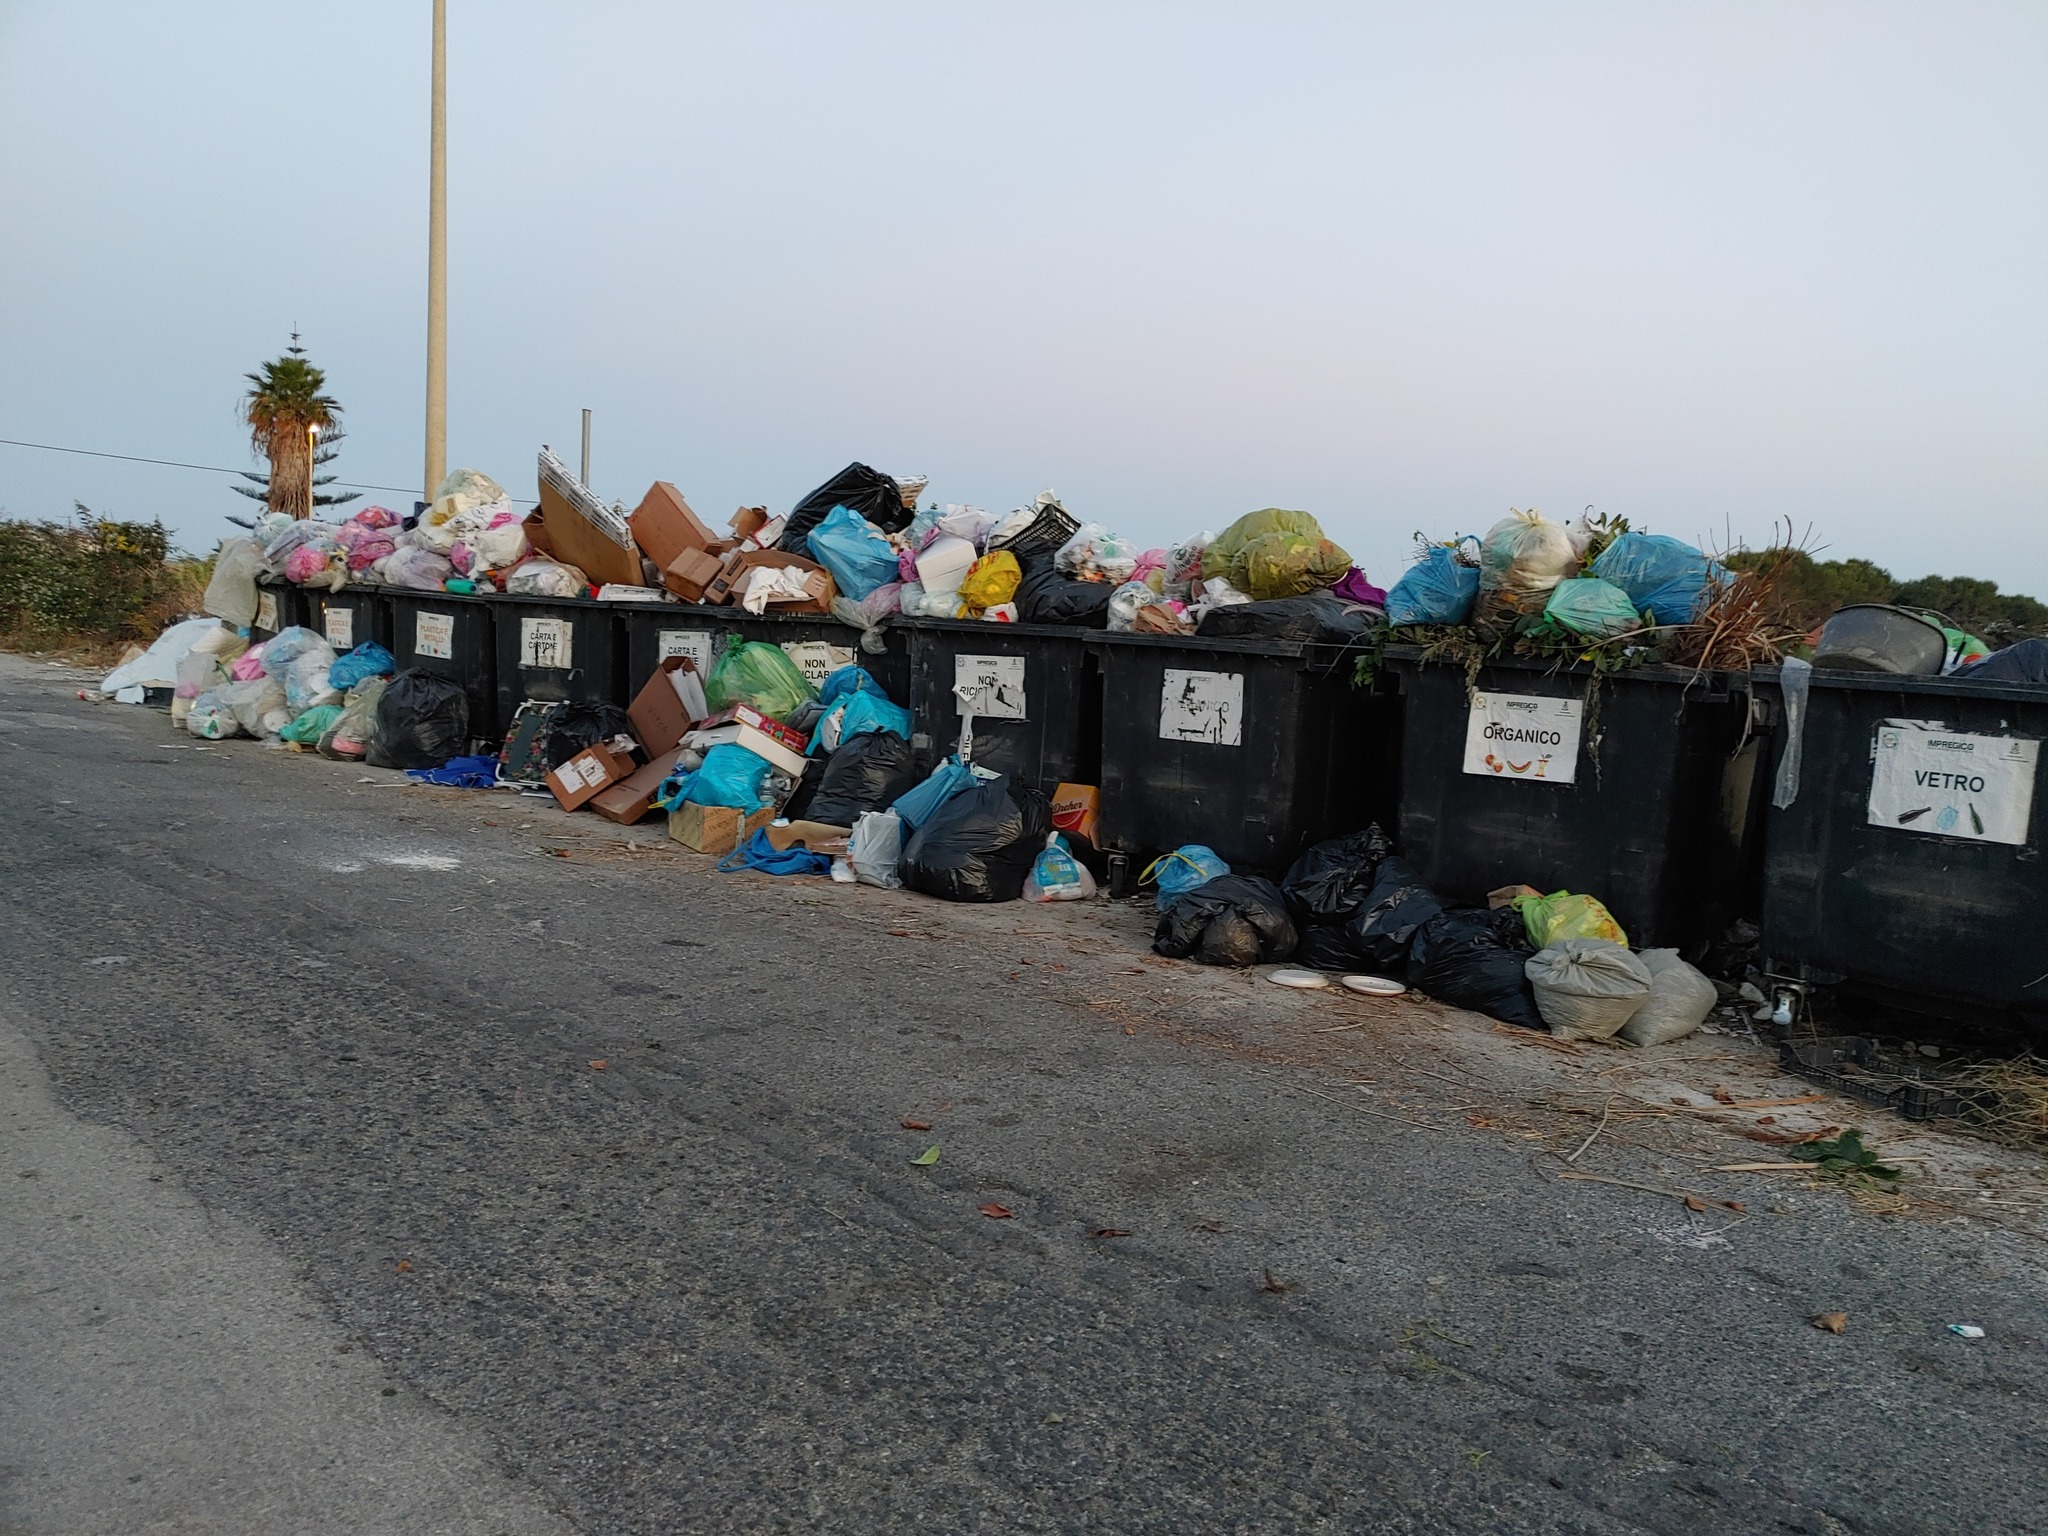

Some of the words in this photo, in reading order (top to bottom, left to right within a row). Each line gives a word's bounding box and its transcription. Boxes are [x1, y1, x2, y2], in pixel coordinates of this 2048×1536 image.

[530, 632, 551, 641] CARTA
[528, 641, 558, 651] CARTONE
[667, 646, 690, 655] CARTA
[692, 647, 698, 655] E
[804, 659, 826, 669] NON
[978, 675, 998, 686] NON
[1483, 726, 1561, 745] ORGANICO
[1926, 739, 1974, 751] IMPREGICO
[1915, 770, 1985, 793] VETRO
[1052, 801, 1083, 813] Dreher
